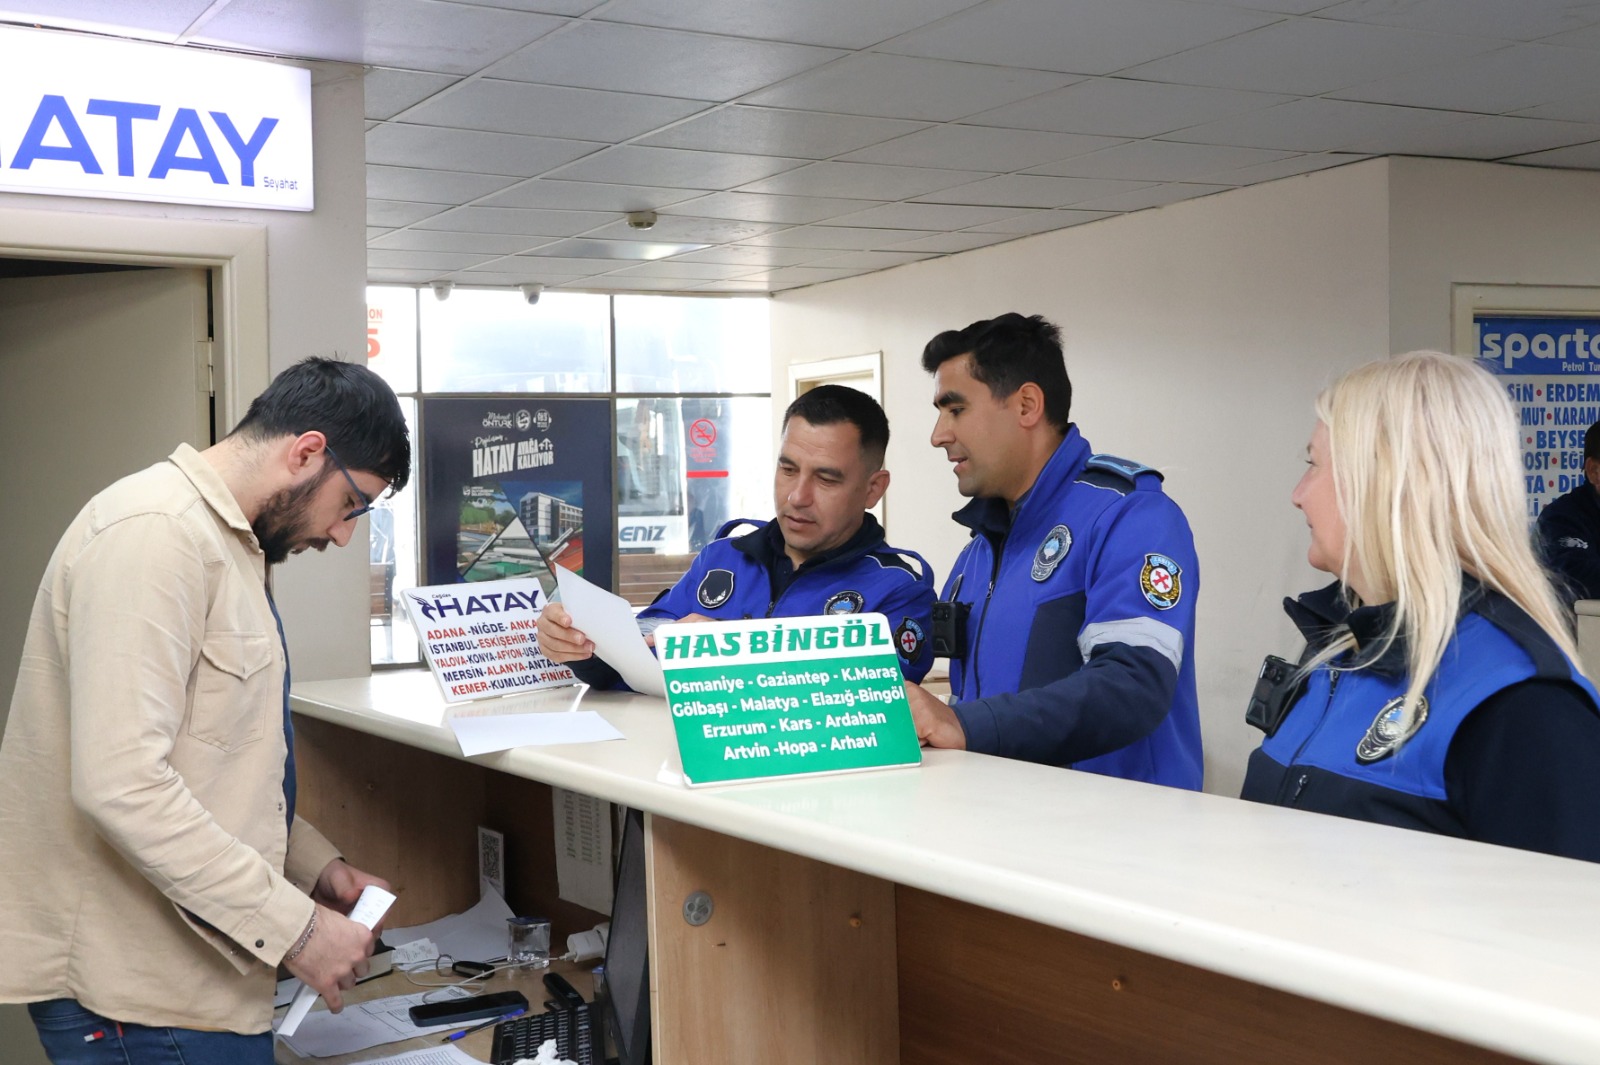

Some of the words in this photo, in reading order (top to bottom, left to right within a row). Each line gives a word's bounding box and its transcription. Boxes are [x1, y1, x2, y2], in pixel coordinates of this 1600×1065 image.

[0, 94, 279, 187] ATAY
[263, 176, 298, 191] Seyahat
[368, 308, 383, 320] ON
[1562, 362, 1585, 372] Petrol
[1506, 384, 1534, 402] SİN
[1520, 407, 1546, 426] MUT
[1553, 406, 1600, 426] KARAM
[517, 438, 539, 456] AYAĞA
[1536, 430, 1585, 449] BEYŞE
[472, 443, 515, 478] HATAY
[517, 451, 554, 470] KALKIYOR
[1521, 451, 1550, 471] OST
[1525, 475, 1545, 494] TA
[434, 590, 539, 618] HATAY
[427, 627, 466, 641] ADANA
[510, 618, 537, 632] ANKA
[664, 631, 741, 660] HAS
[749, 619, 889, 654] BİNGÖL
[429, 633, 537, 655] İSTANBUL-ESKİŞEHİR-B
[434, 647, 542, 669] YALOVA-KONYA-AFYON-UŞA
[443, 658, 564, 683] MERSİN-ALANYA-ANTAL
[669, 675, 744, 694] Osmaniye
[757, 668, 830, 688] Gaziantep
[841, 666, 898, 682] K.Maraş
[672, 702, 729, 718] Gölbaşı
[740, 694, 799, 713] Malatya
[703, 721, 767, 739] Erzurum
[779, 717, 813, 733] Kars
[825, 711, 886, 728] Ardahan
[723, 743, 770, 761] Artvin
[830, 732, 877, 750] Arhavi
